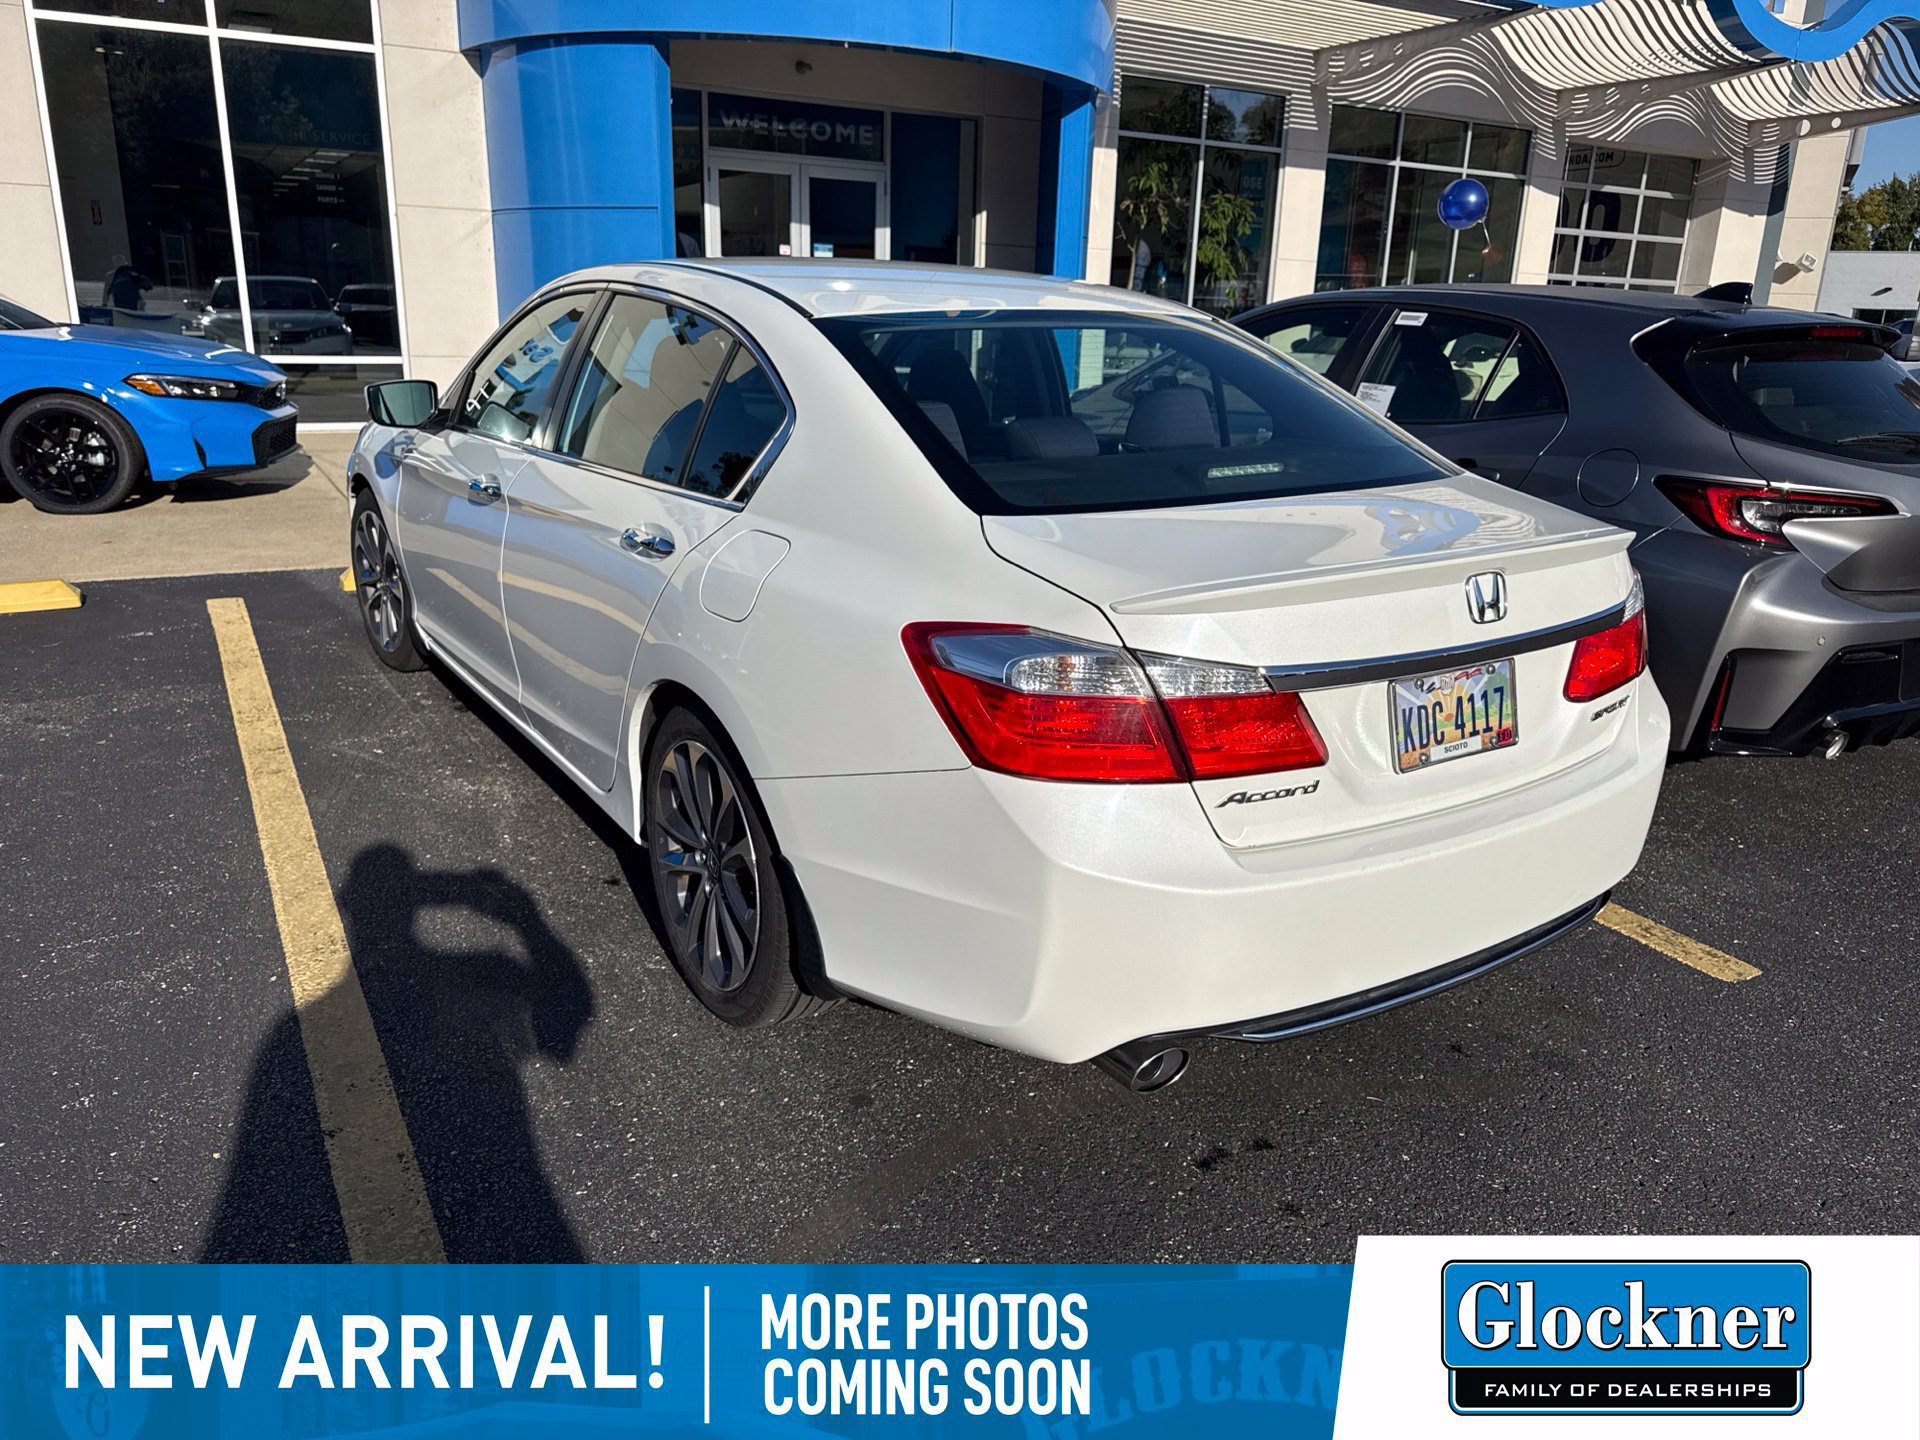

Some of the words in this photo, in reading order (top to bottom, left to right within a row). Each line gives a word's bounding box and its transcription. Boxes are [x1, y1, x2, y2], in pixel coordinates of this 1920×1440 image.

[312, 129, 371, 146] SERVICE
[720, 110, 874, 145] WELCOME
[1401, 700, 1446, 754] KDC
[1454, 685, 1505, 740] 4117
[1444, 741, 1469, 754] SCIOTO
[1214, 779, 1321, 809] Accord
